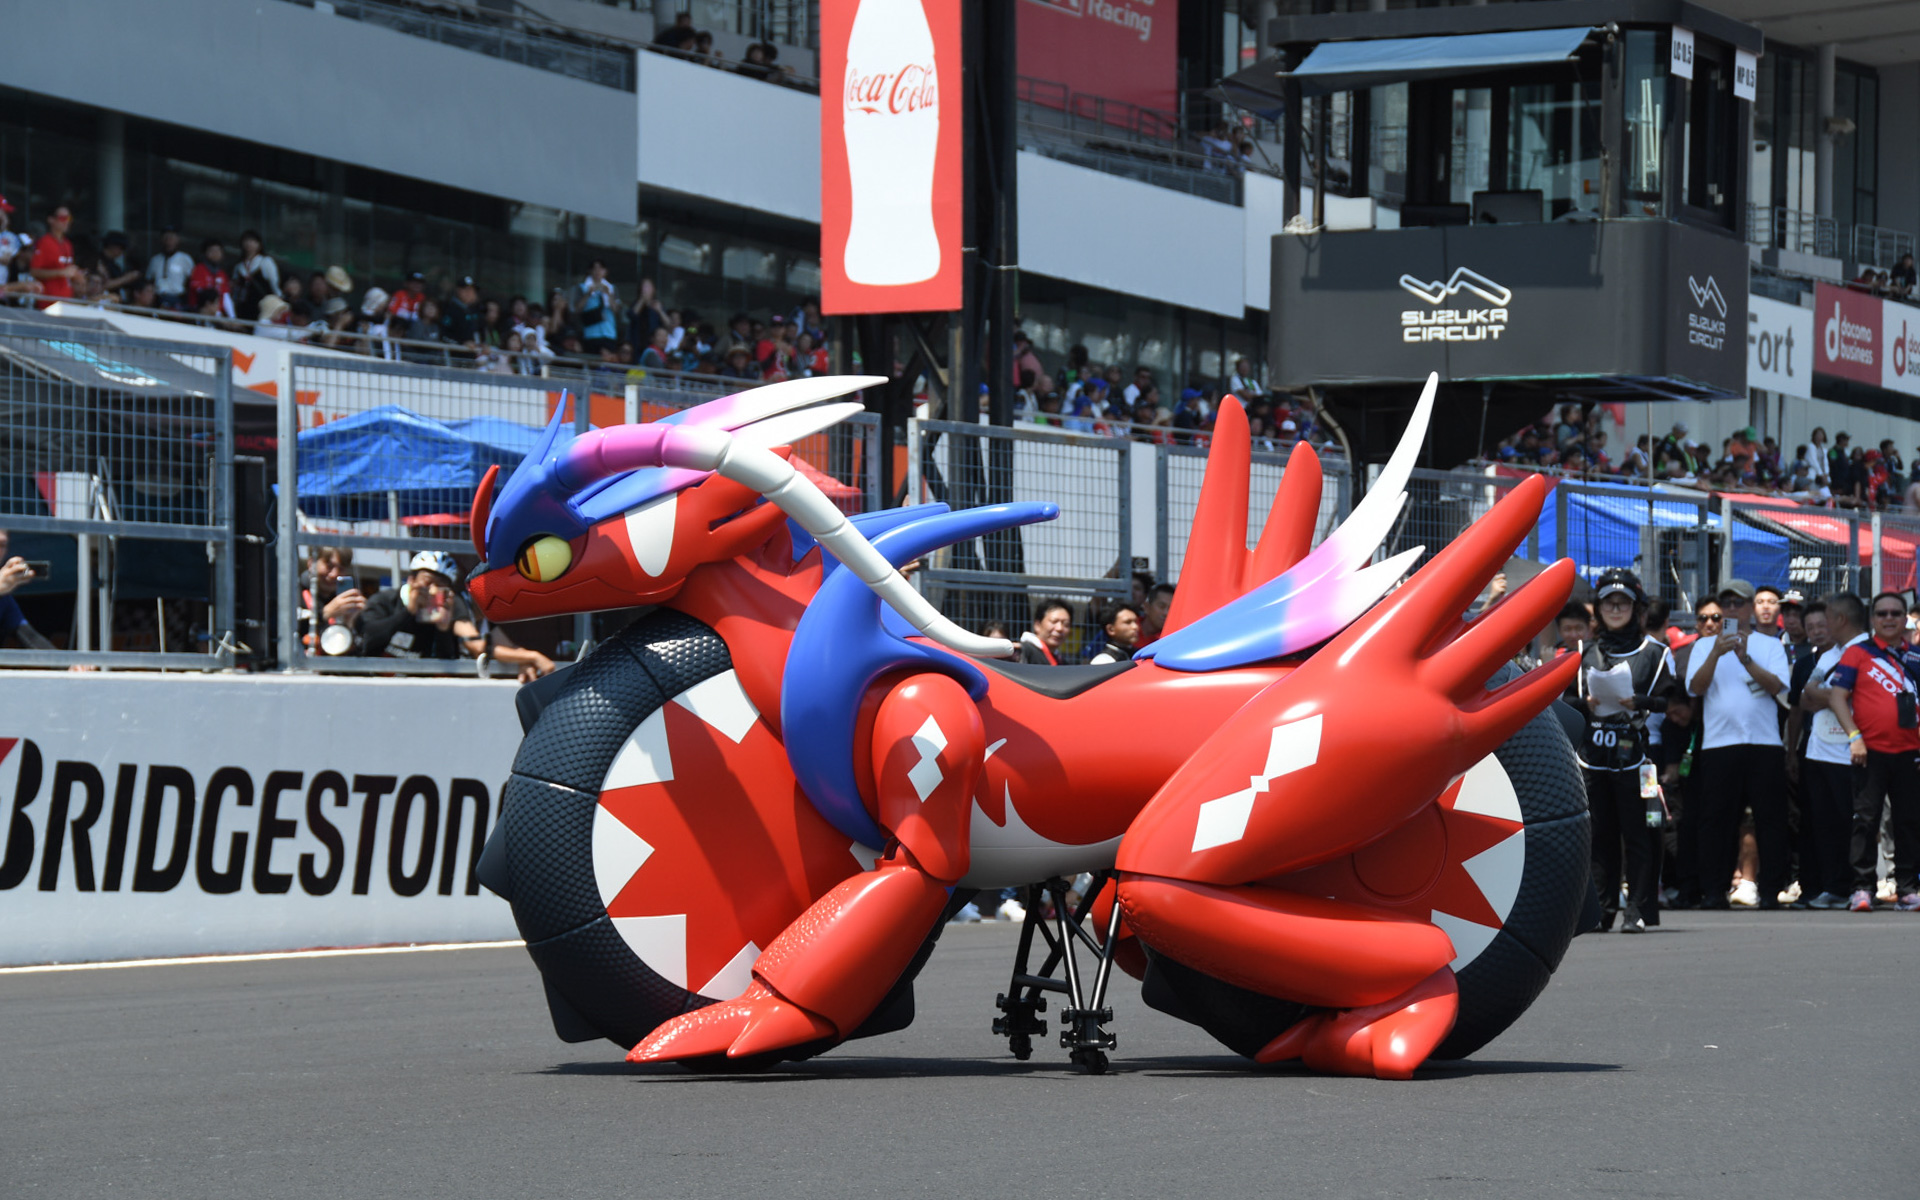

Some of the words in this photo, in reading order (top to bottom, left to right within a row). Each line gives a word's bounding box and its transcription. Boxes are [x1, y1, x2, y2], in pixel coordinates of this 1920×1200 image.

[1087, 0, 1153, 41] Racing
[846, 63, 935, 115] Coca-Cola
[1401, 308, 1509, 326] SUZUKA
[1689, 313, 1726, 336] SUZUKA
[1841, 316, 1873, 343] docomo
[1403, 325, 1506, 343] CIRCUIT
[1689, 330, 1725, 351] CIRCUIT
[1841, 336, 1874, 366] business
[1592, 729, 1617, 747] 00
[0, 738, 508, 898] BRIDGESTON
